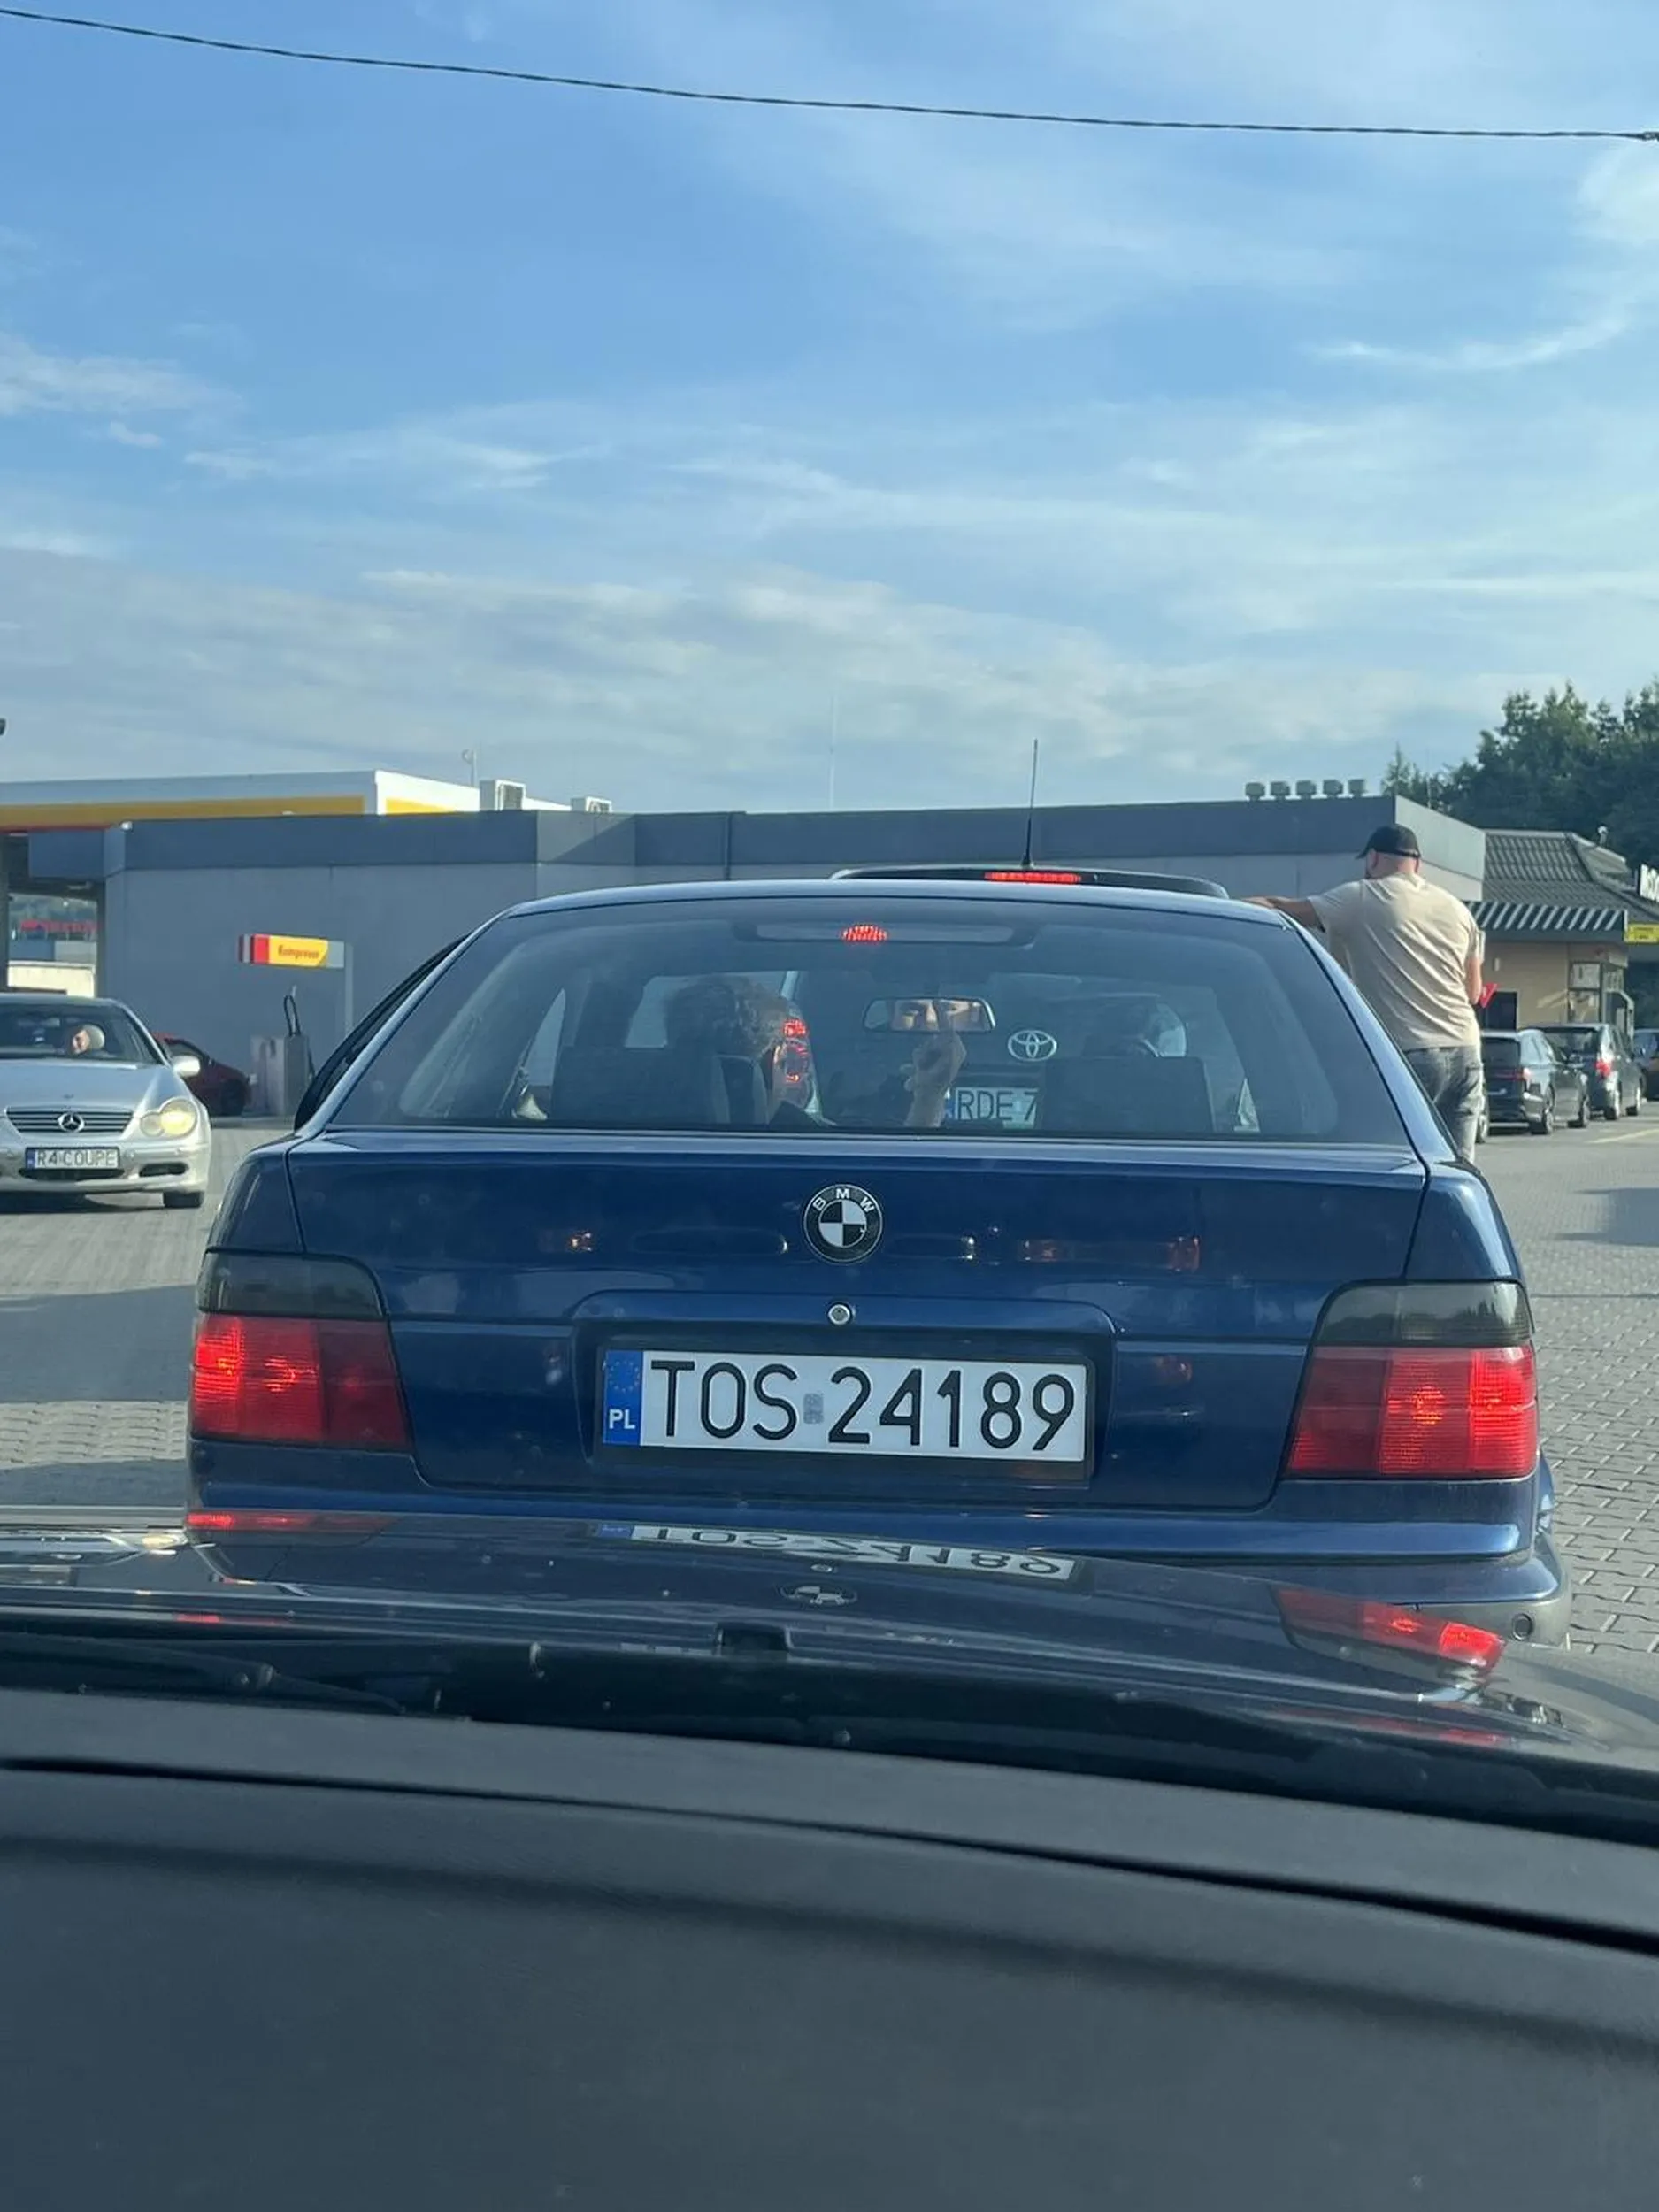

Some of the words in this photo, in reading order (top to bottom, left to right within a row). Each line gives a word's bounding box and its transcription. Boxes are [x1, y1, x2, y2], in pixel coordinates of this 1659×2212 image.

[957, 1090, 1013, 1121] RDE
[63, 1150, 117, 1166] COUPE
[812, 1188, 875, 1213] BMW
[651, 1360, 798, 1440] TOS
[828, 1366, 1075, 1451] 24189
[609, 1409, 636, 1430] PL
